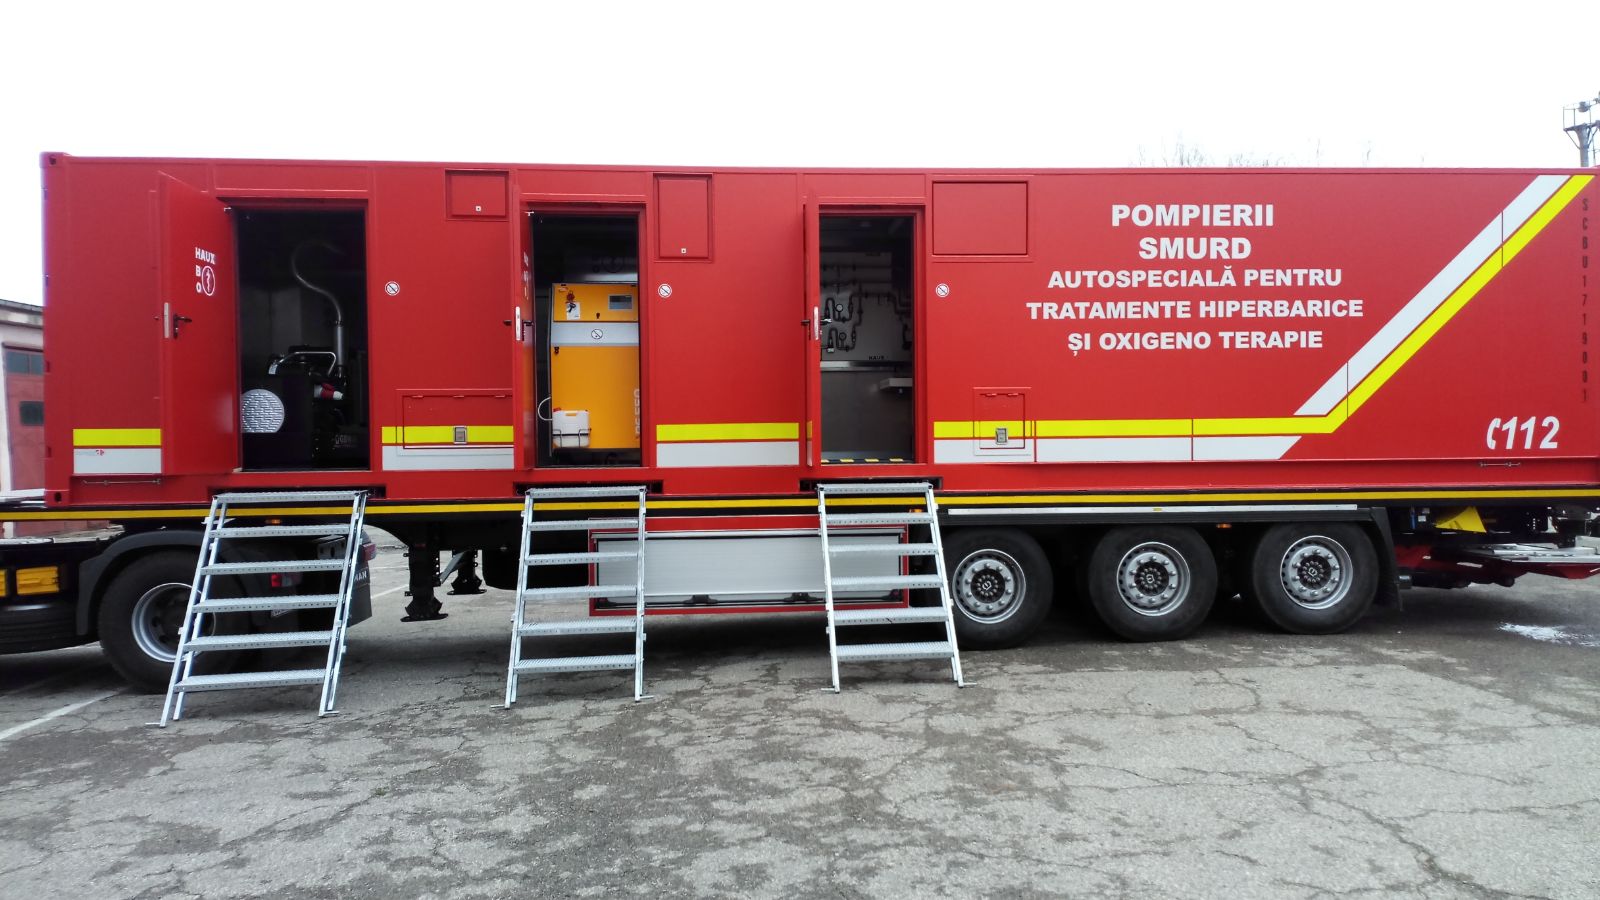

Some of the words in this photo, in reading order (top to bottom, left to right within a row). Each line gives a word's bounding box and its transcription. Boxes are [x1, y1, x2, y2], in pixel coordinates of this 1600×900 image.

[1112, 204, 1274, 226] POMPIERII
[195, 247, 215, 264] HAUX
[1139, 237, 1252, 259] SMURD
[1048, 265, 1236, 288] AUTOSPECIALĂ
[1245, 269, 1342, 286] PENTRU
[1026, 301, 1192, 319] TRATAMENTE
[1200, 299, 1364, 317] HIPERBARICE
[1068, 333, 1091, 356] ȘI
[1100, 331, 1211, 350] OXIGENO
[1219, 331, 1323, 348] TERAPIE
